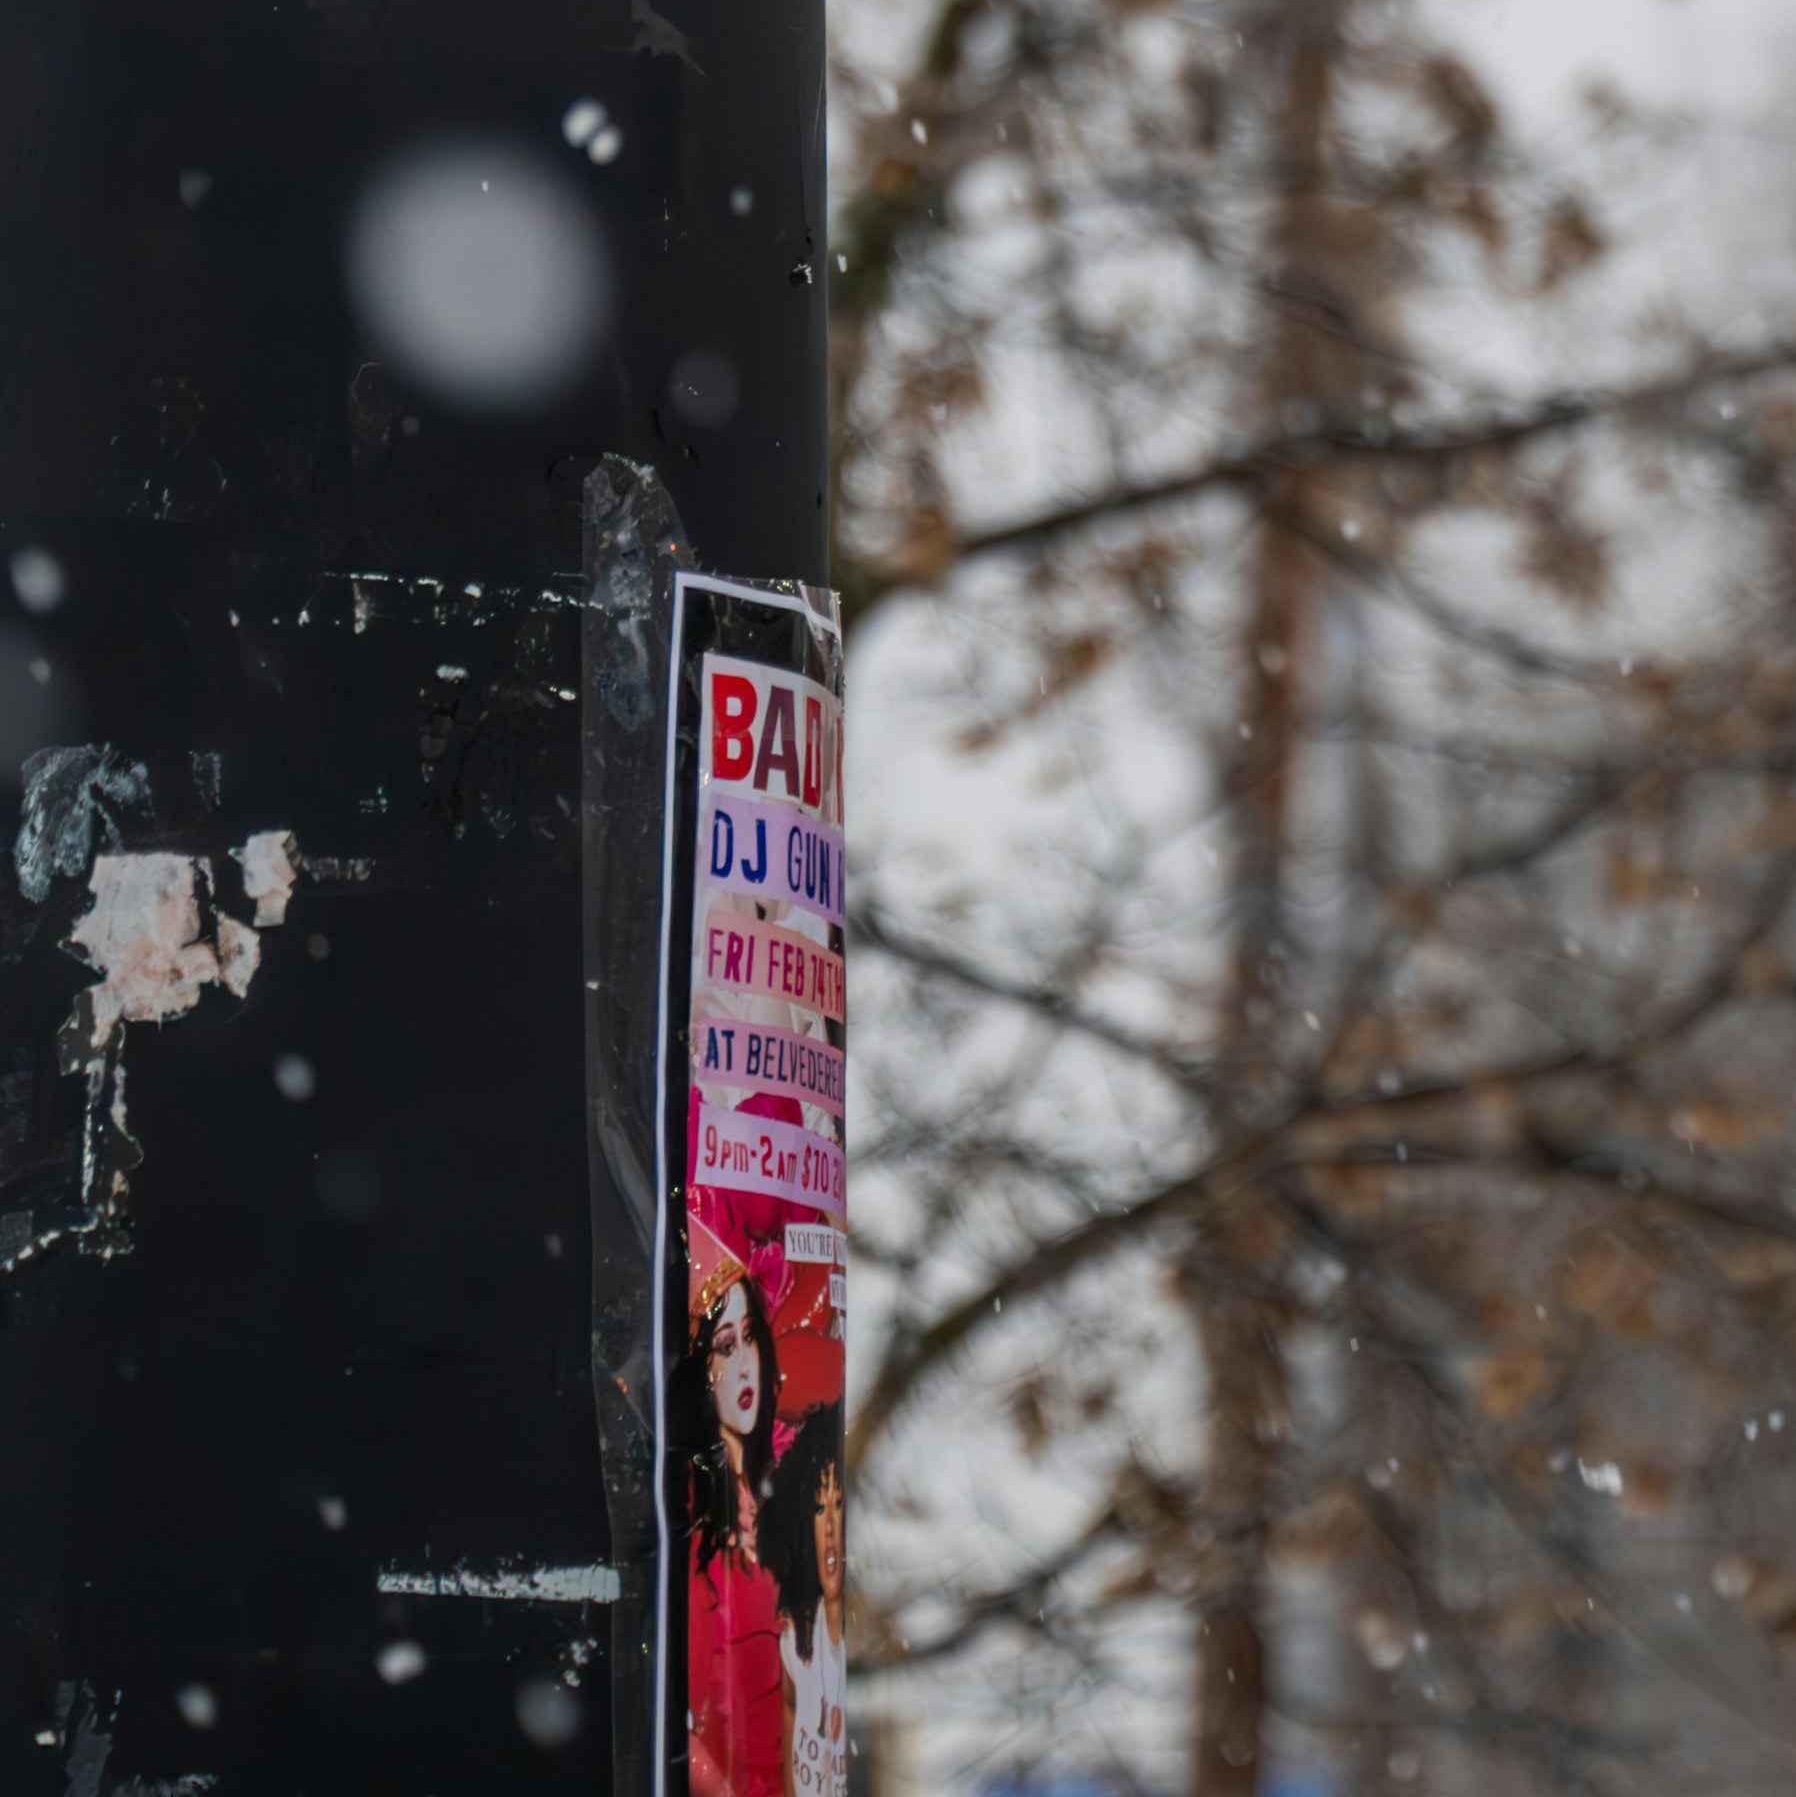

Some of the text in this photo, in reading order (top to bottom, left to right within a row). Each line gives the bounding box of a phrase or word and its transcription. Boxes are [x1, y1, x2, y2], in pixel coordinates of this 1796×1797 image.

[712, 673, 822, 809] BAD
[711, 808, 767, 885] DJ
[787, 825, 830, 910] GUN
[708, 927, 844, 1015] FRI FEB 14TH
[705, 1027, 735, 1072] AT
[802, 1143, 829, 1194] $10
[789, 1230, 833, 1257] YOU'RE
[799, 1727, 819, 1761] TO
